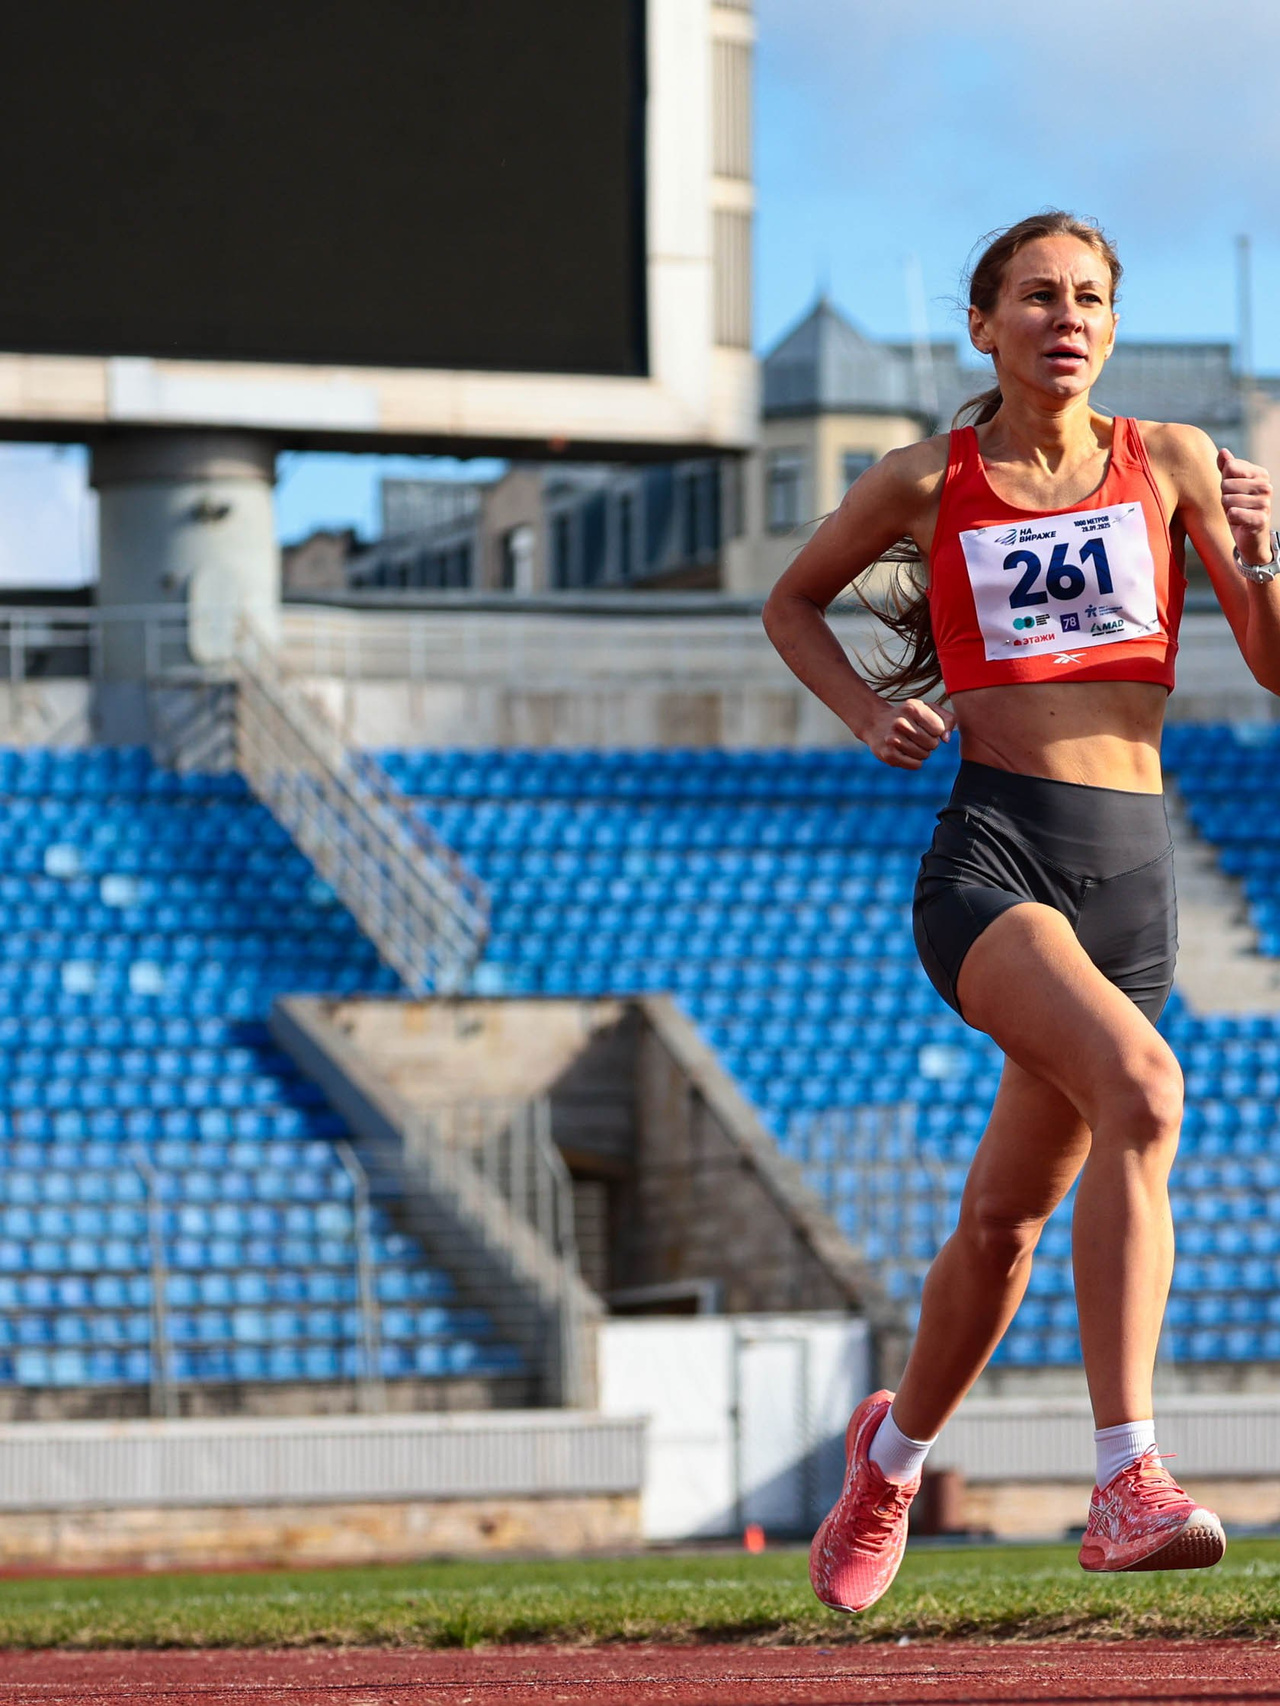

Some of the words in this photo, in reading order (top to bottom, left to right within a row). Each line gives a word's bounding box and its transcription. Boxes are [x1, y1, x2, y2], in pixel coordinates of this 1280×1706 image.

[1086, 515, 1109, 525] МЕТРОВ
[1019, 530, 1056, 543] ВИРАЖЕ
[1020, 528, 1032, 536] НА
[1003, 537, 1113, 609] 261
[1063, 616, 1077, 630] 78
[1022, 633, 1055, 645] этажи
